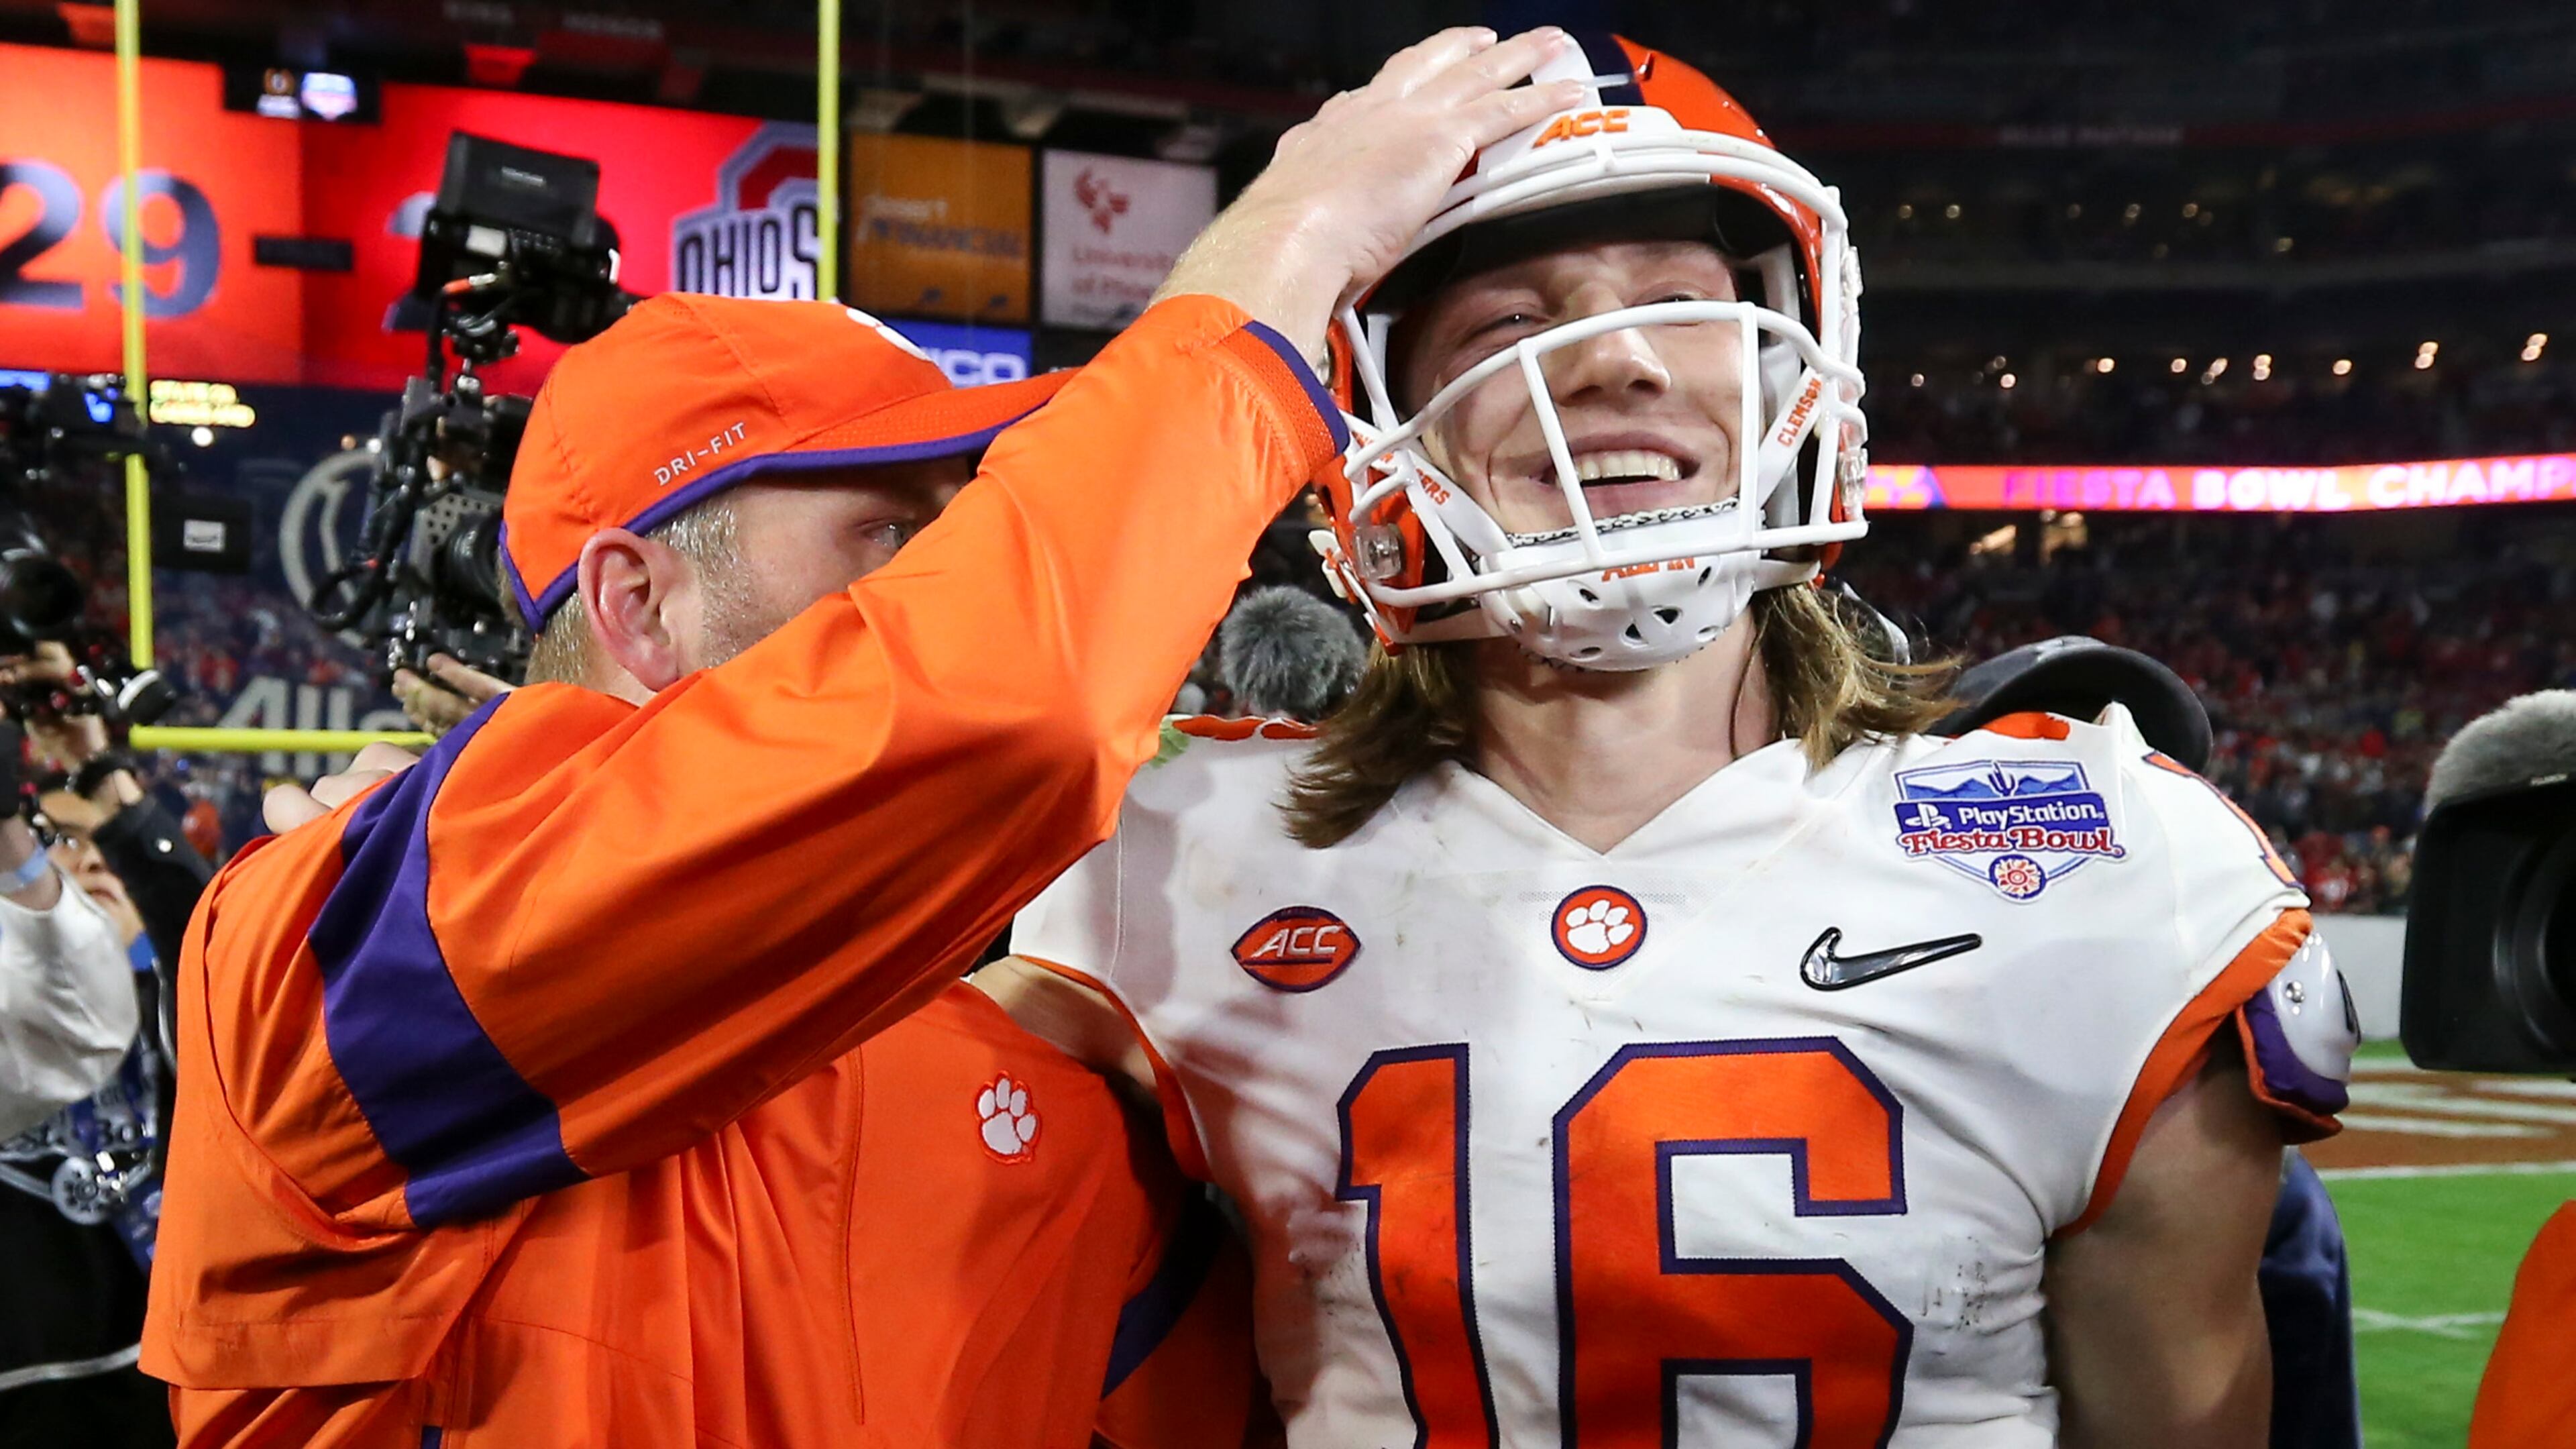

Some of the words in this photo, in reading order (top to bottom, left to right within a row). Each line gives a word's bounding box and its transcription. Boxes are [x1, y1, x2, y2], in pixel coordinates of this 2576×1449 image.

[1532, 109, 1629, 148] ACC
[0, 162, 219, 318] 29
[1777, 378, 1821, 447] CLEMSON
[654, 422, 745, 486] DRI-FIT
[2003, 469, 2176, 508] FIESTA
[2192, 468, 2351, 511] BOWL
[2367, 457, 2576, 508] CHAMP
[1900, 829, 2007, 854] Fiesta
[2010, 826, 2114, 852] Bowl
[1957, 801, 2098, 829] PlayStation
[1250, 925, 1343, 958] ACC
[1335, 1035, 1913, 1449] 16
